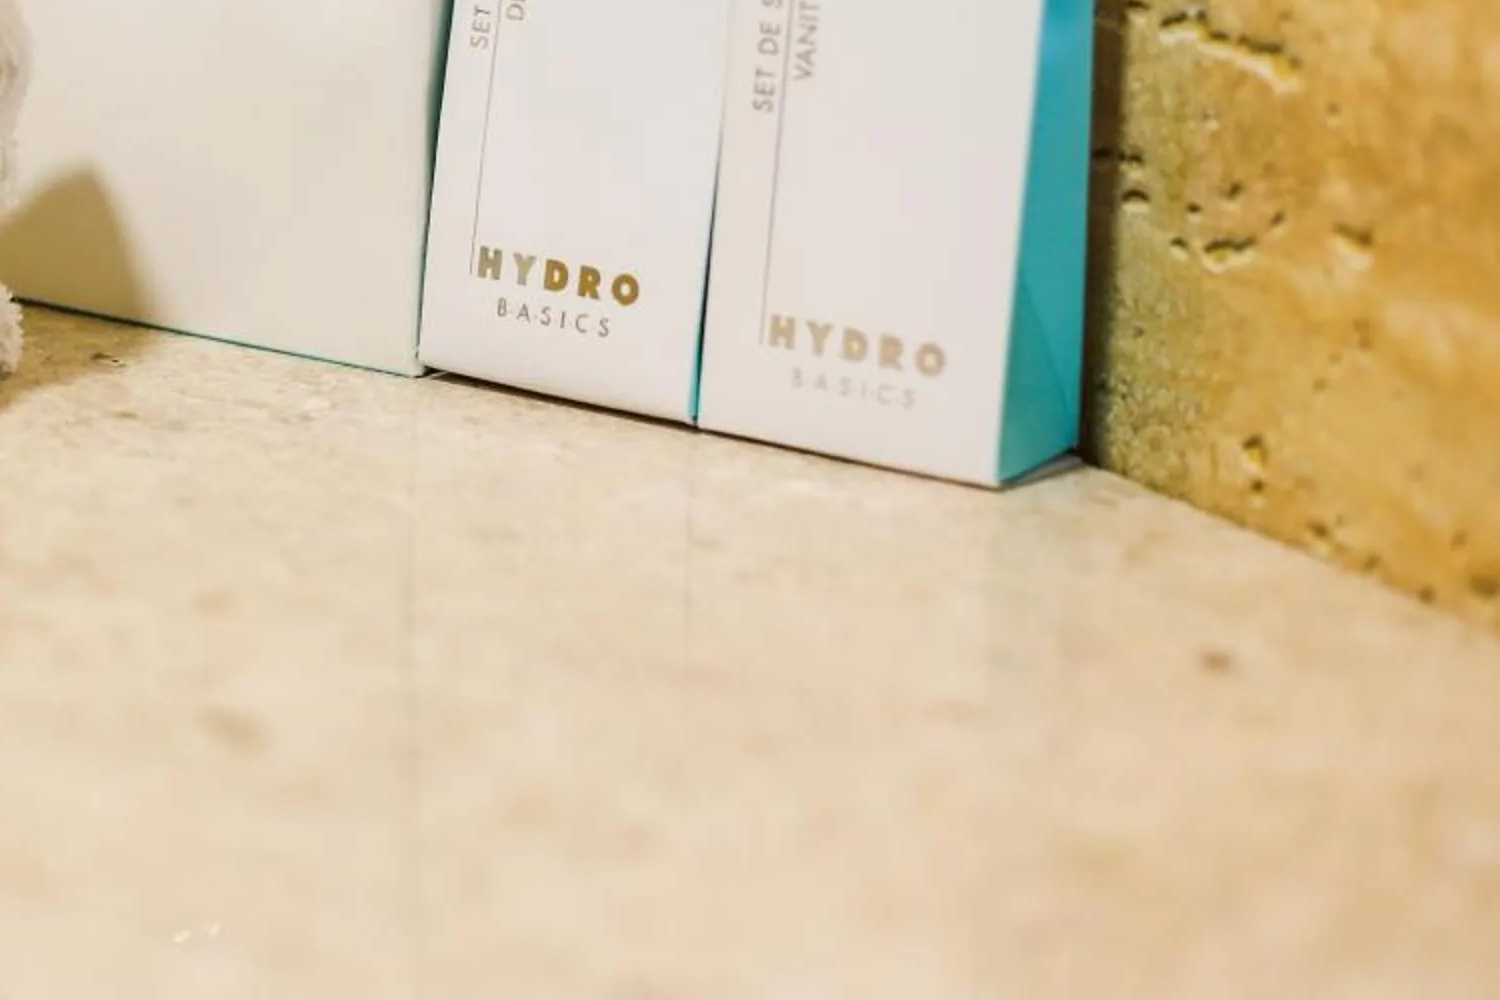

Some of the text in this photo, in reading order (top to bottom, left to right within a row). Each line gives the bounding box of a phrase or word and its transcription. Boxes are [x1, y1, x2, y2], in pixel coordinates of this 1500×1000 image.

[470, 6, 493, 49] SET
[757, 21, 782, 57] DE
[752, 68, 777, 113] SET
[477, 245, 642, 307] HYDRO
[496, 298, 611, 338] BASICS
[769, 313, 947, 379] HYDRO
[790, 364, 917, 412] BASICS
